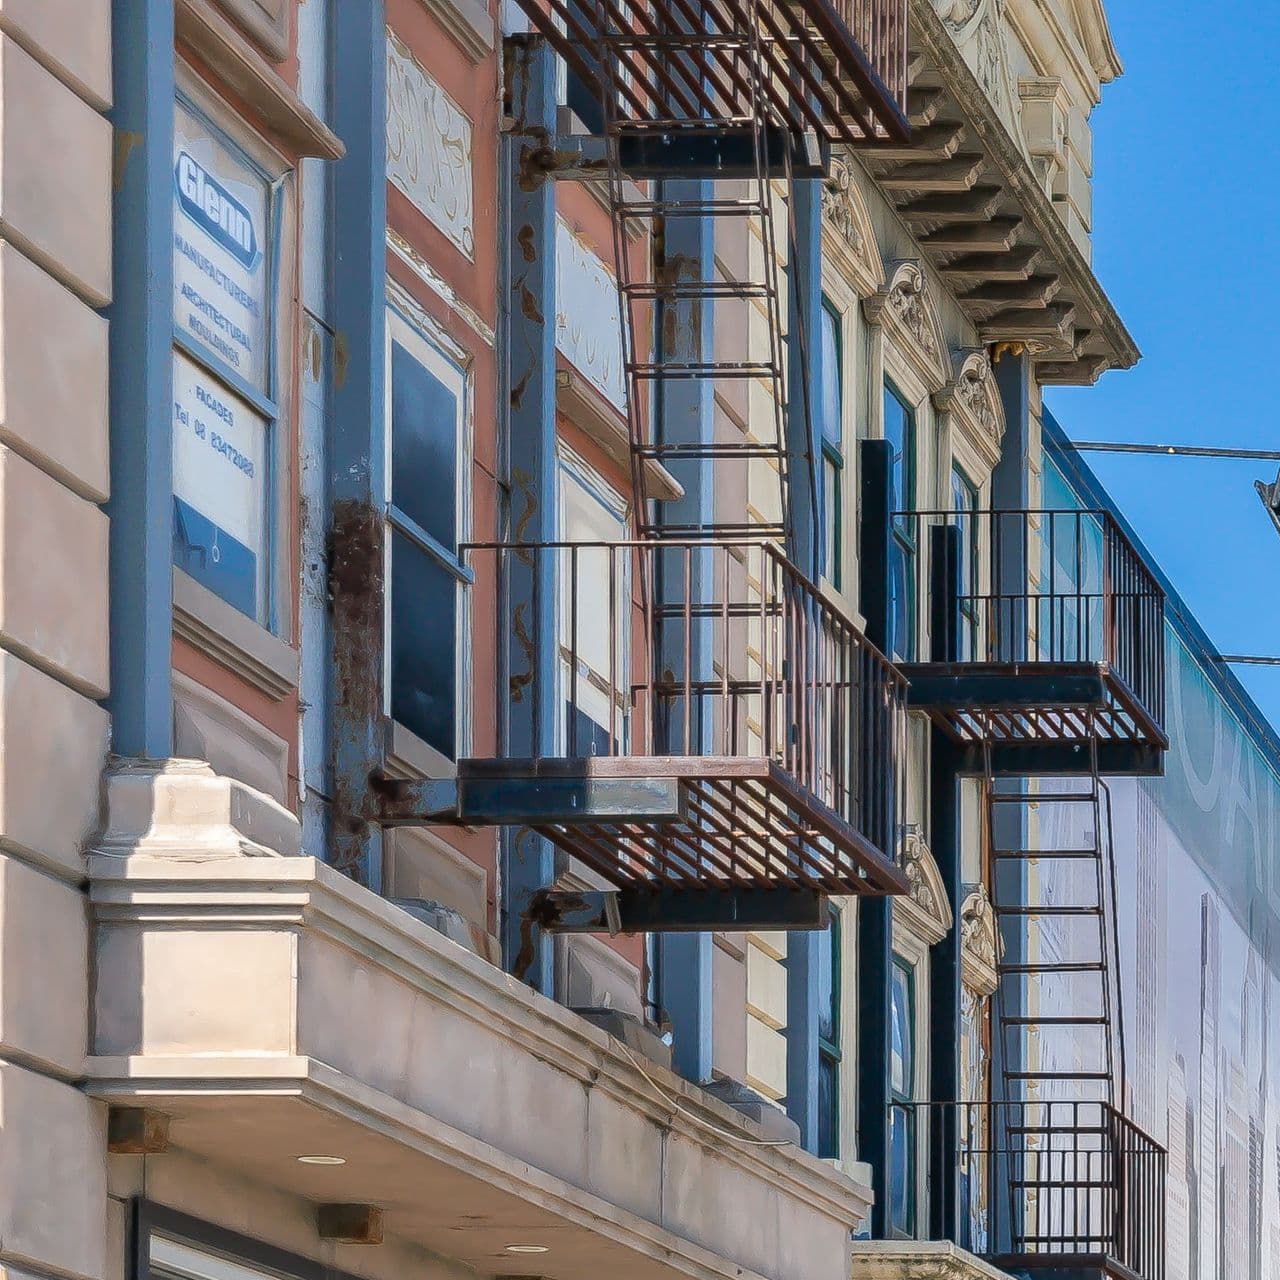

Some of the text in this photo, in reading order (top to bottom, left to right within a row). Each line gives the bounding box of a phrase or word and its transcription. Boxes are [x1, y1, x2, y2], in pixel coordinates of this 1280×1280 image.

[179, 155, 252, 254] Glenn
[181, 282, 252, 353] ARCHITECTURAL
[175, 402, 189, 428] Tel
